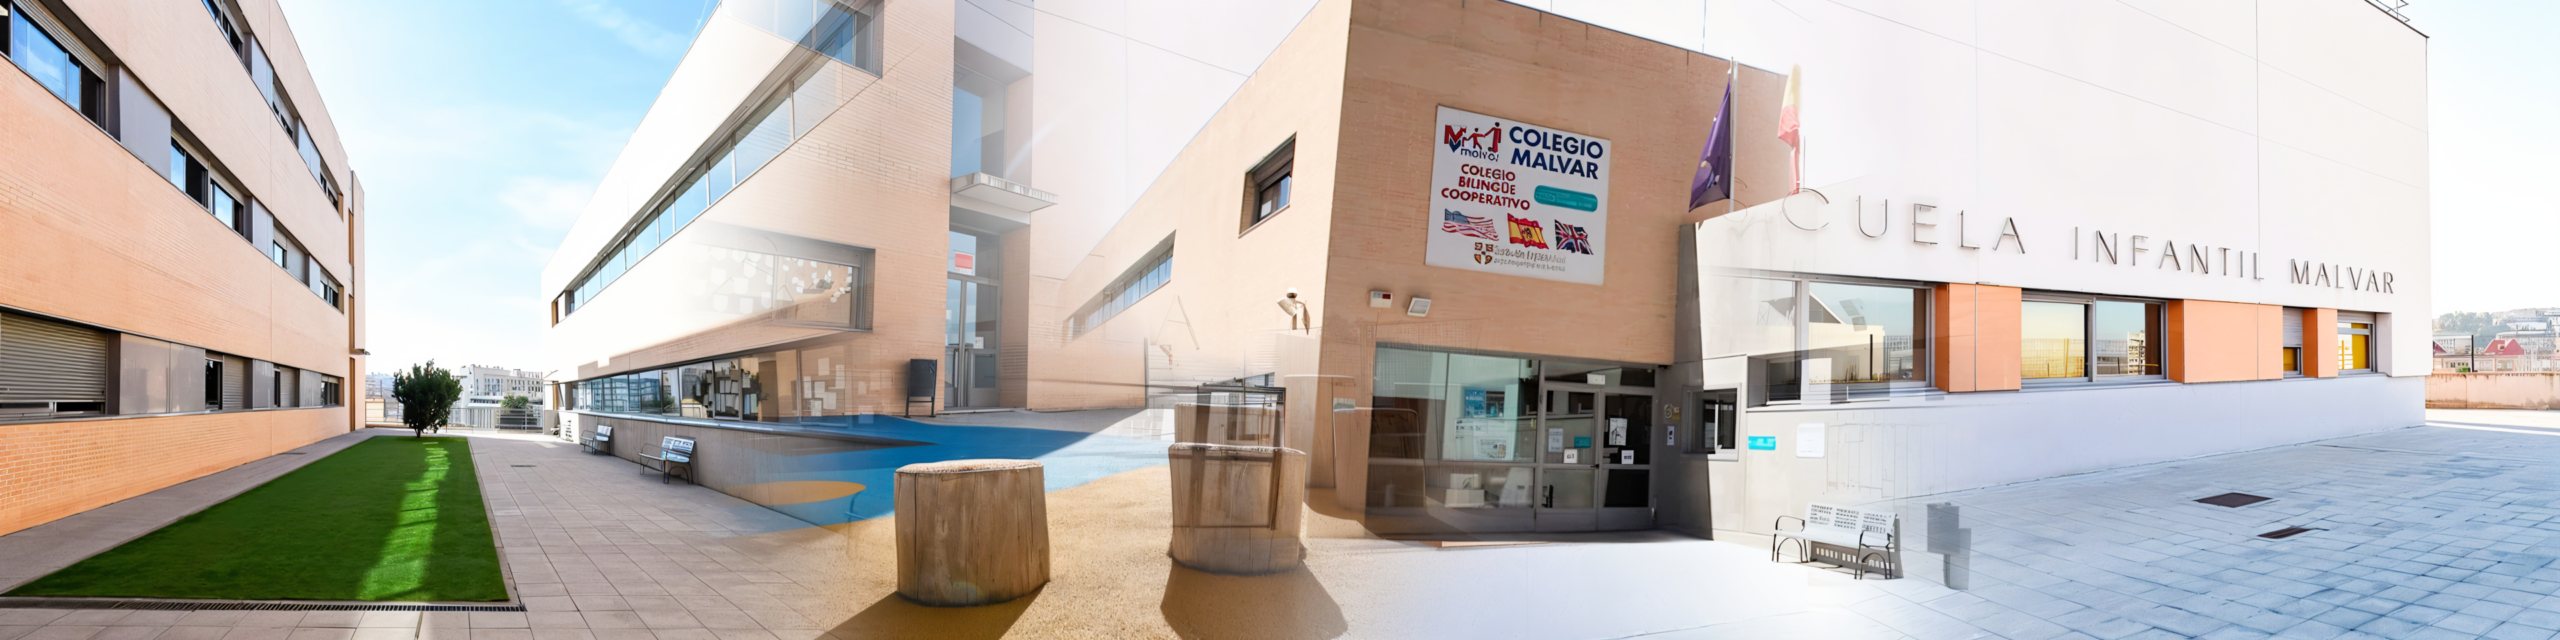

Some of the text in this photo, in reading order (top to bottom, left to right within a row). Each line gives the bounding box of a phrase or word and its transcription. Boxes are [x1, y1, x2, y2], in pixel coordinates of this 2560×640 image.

[1509, 126, 1603, 159] COLEGIO
[1461, 163, 1516, 181] COLEGIO
[1510, 147, 1598, 180] MALVAR
[1441, 187, 1530, 210] COOPERATIVO
[2074, 226, 2265, 282] INFANTIL
[2289, 258, 2394, 294] MALVAR
